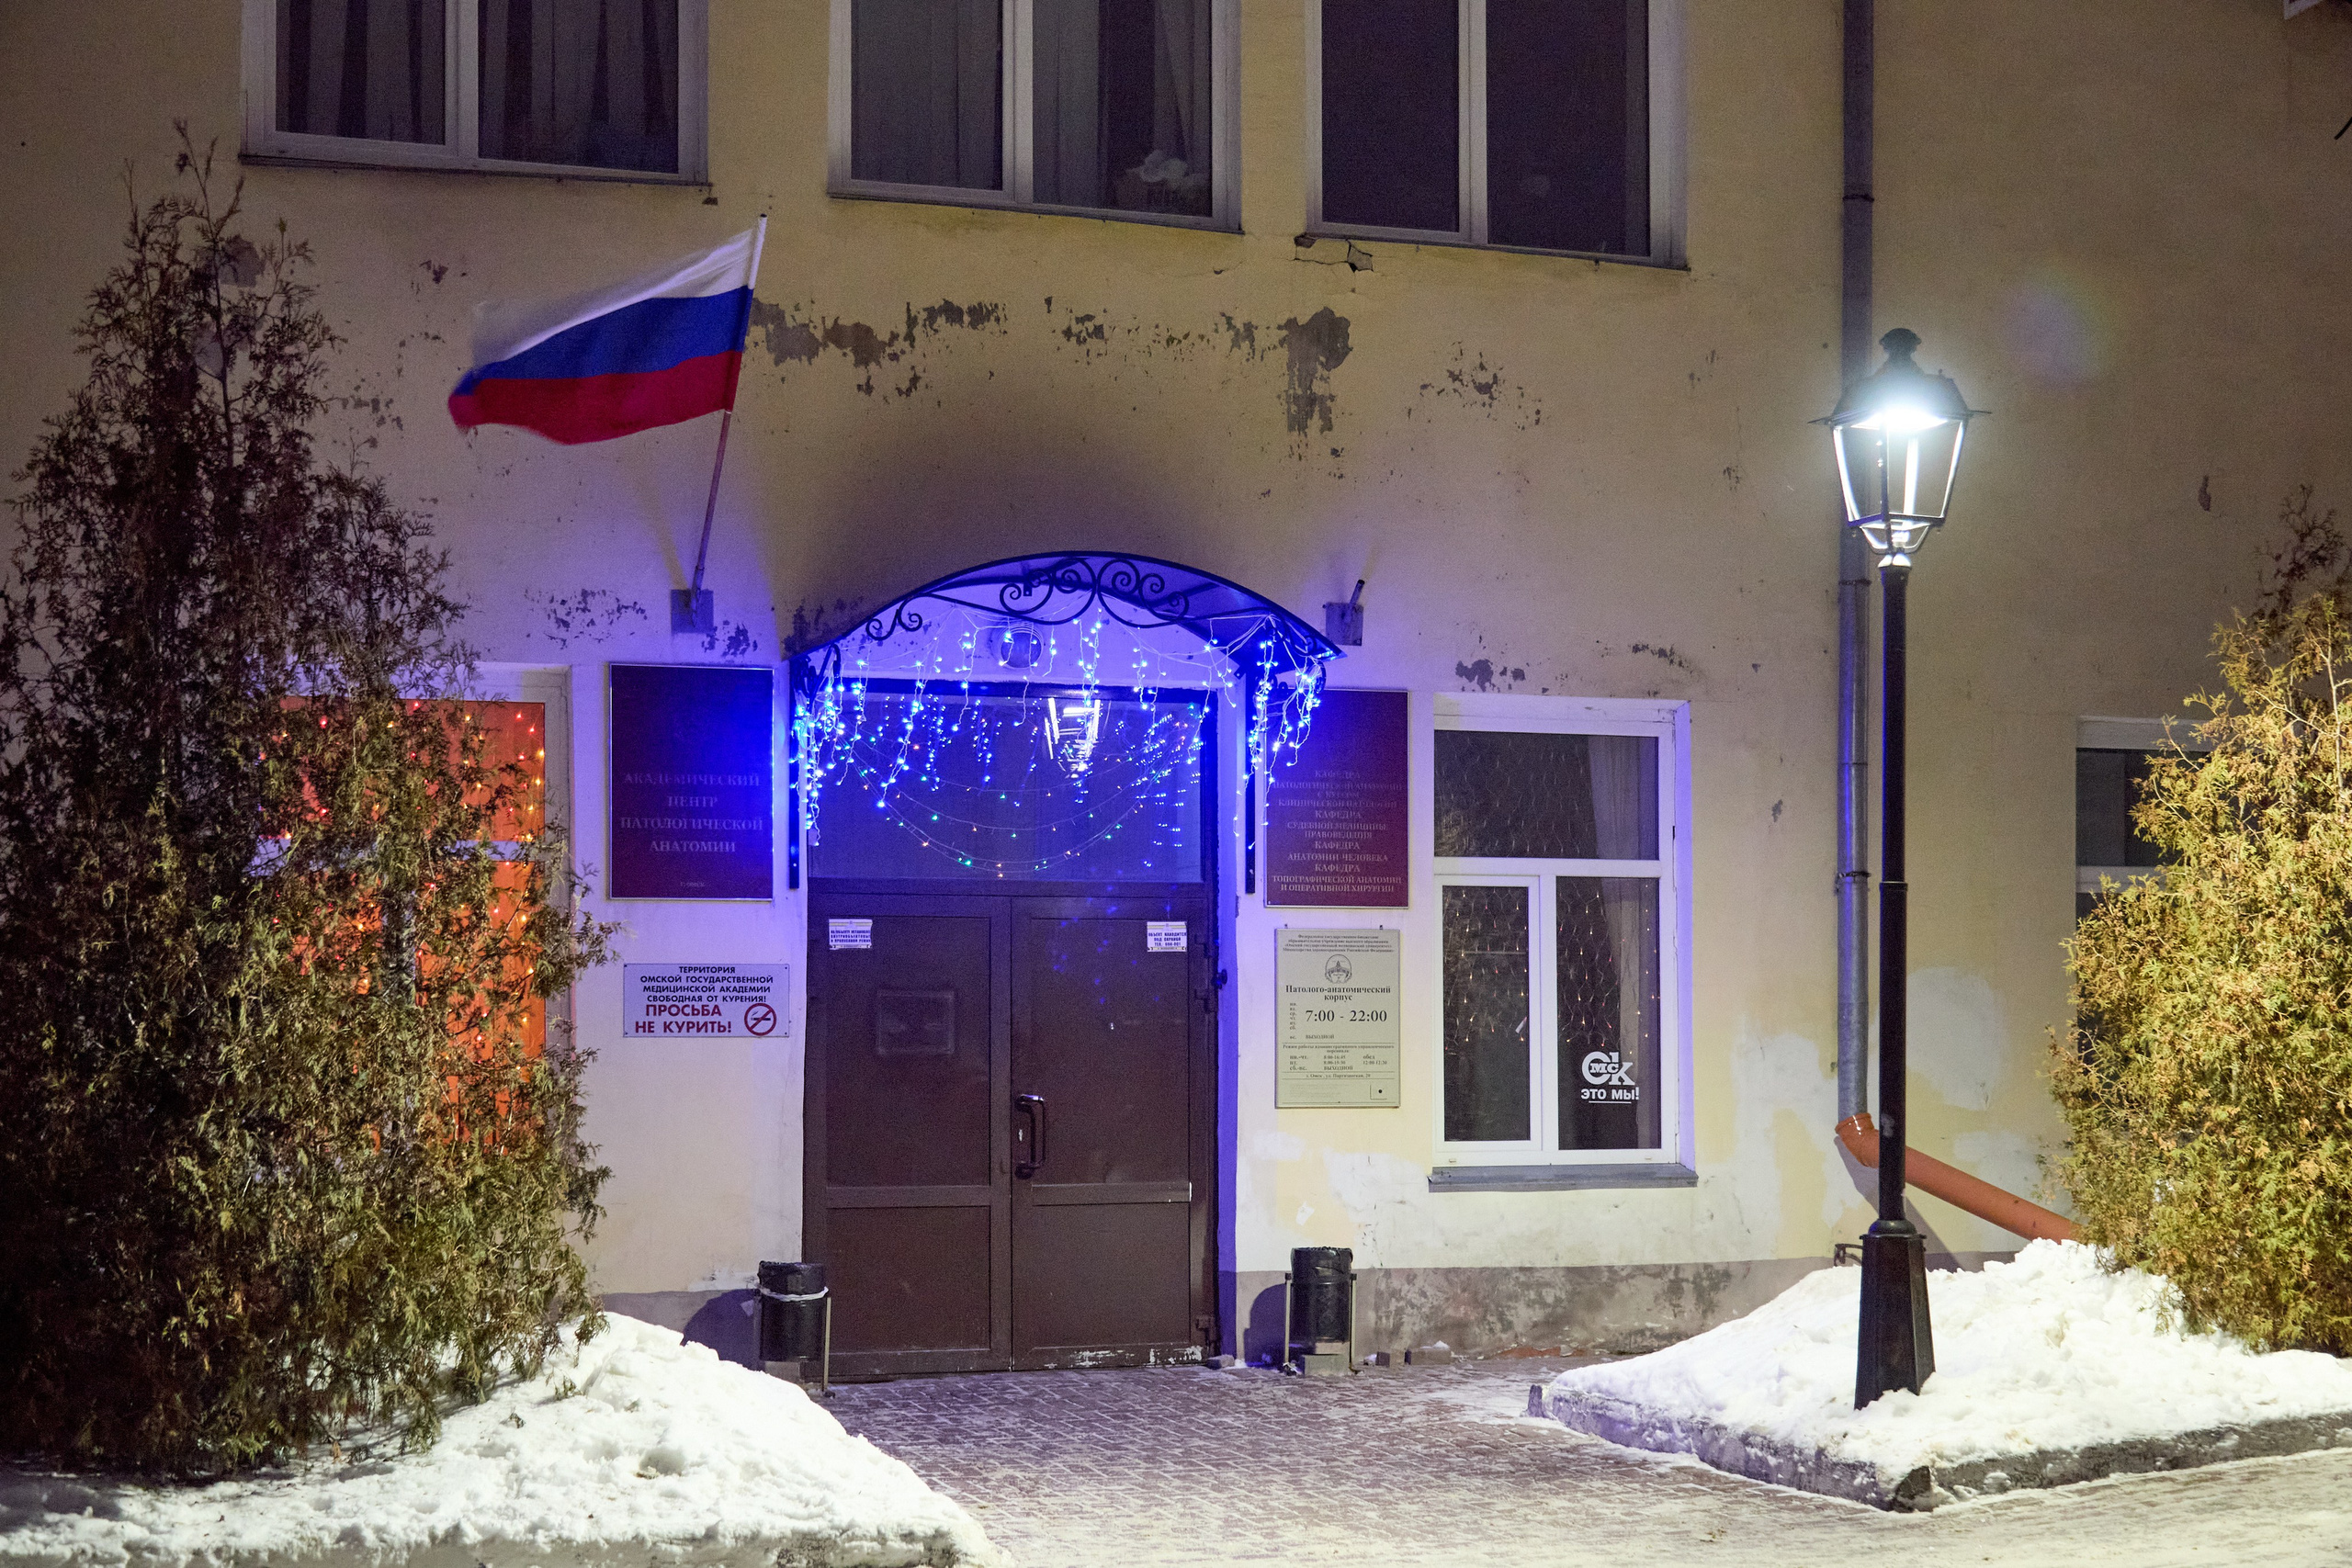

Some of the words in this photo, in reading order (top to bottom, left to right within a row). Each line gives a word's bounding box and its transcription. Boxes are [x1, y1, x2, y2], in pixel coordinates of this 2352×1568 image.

[667, 795, 718, 807] ЦЕНТР
[1315, 810, 1362, 819] КАФЕДРА
[620, 816, 763, 830] ПАТОЛОГИЧЕСКОЙ
[1286, 820, 1333, 830] СУДЕБНОЙ
[650, 840, 736, 852] АНАТОМИИ
[1315, 840, 1361, 850] КАФЕДРА
[1287, 852, 1340, 862] АНАТОМИИ
[1341, 853, 1388, 863] ЧЕЛОВЕКА
[1315, 863, 1361, 873] КАФЕДРА
[1272, 874, 1355, 884] ТОПОГРАФИЧЕСКОЙ
[1356, 875, 1402, 885] АНАТОМИИ
[1288, 884, 1351, 893] ОПЕРАТИВНОЙ
[1351, 885, 1396, 893] ХИРУРГИИ
[678, 965, 736, 974] ТЕРРИТОРИЯ
[640, 974, 682, 984] ОМСКОЙ
[685, 975, 774, 985] ГОСУДАРСТВЕННОЙ
[643, 984, 716, 994] МЕДИЦИНСКОЙ
[719, 986, 772, 994] АКАДЕМИИ
[1285, 985, 1392, 994] Патолого-анатомический
[647, 995, 704, 1003] СВОБОДНАЯ
[707, 995, 718, 1003] ОТ
[722, 995, 767, 1003] КУРЕНИЯ!
[1324, 995, 1353, 1003] корпус
[645, 1004, 723, 1017] ПРОСЬБА
[1306, 1010, 1336, 1022] 7:00
[1349, 1010, 1388, 1022] 22:00
[635, 1021, 655, 1033] НЕ
[662, 1021, 732, 1033] КУРИТЬ!
[1580, 1089, 1607, 1100] ЭТО
[1611, 1087, 1640, 1100] МЫ!
